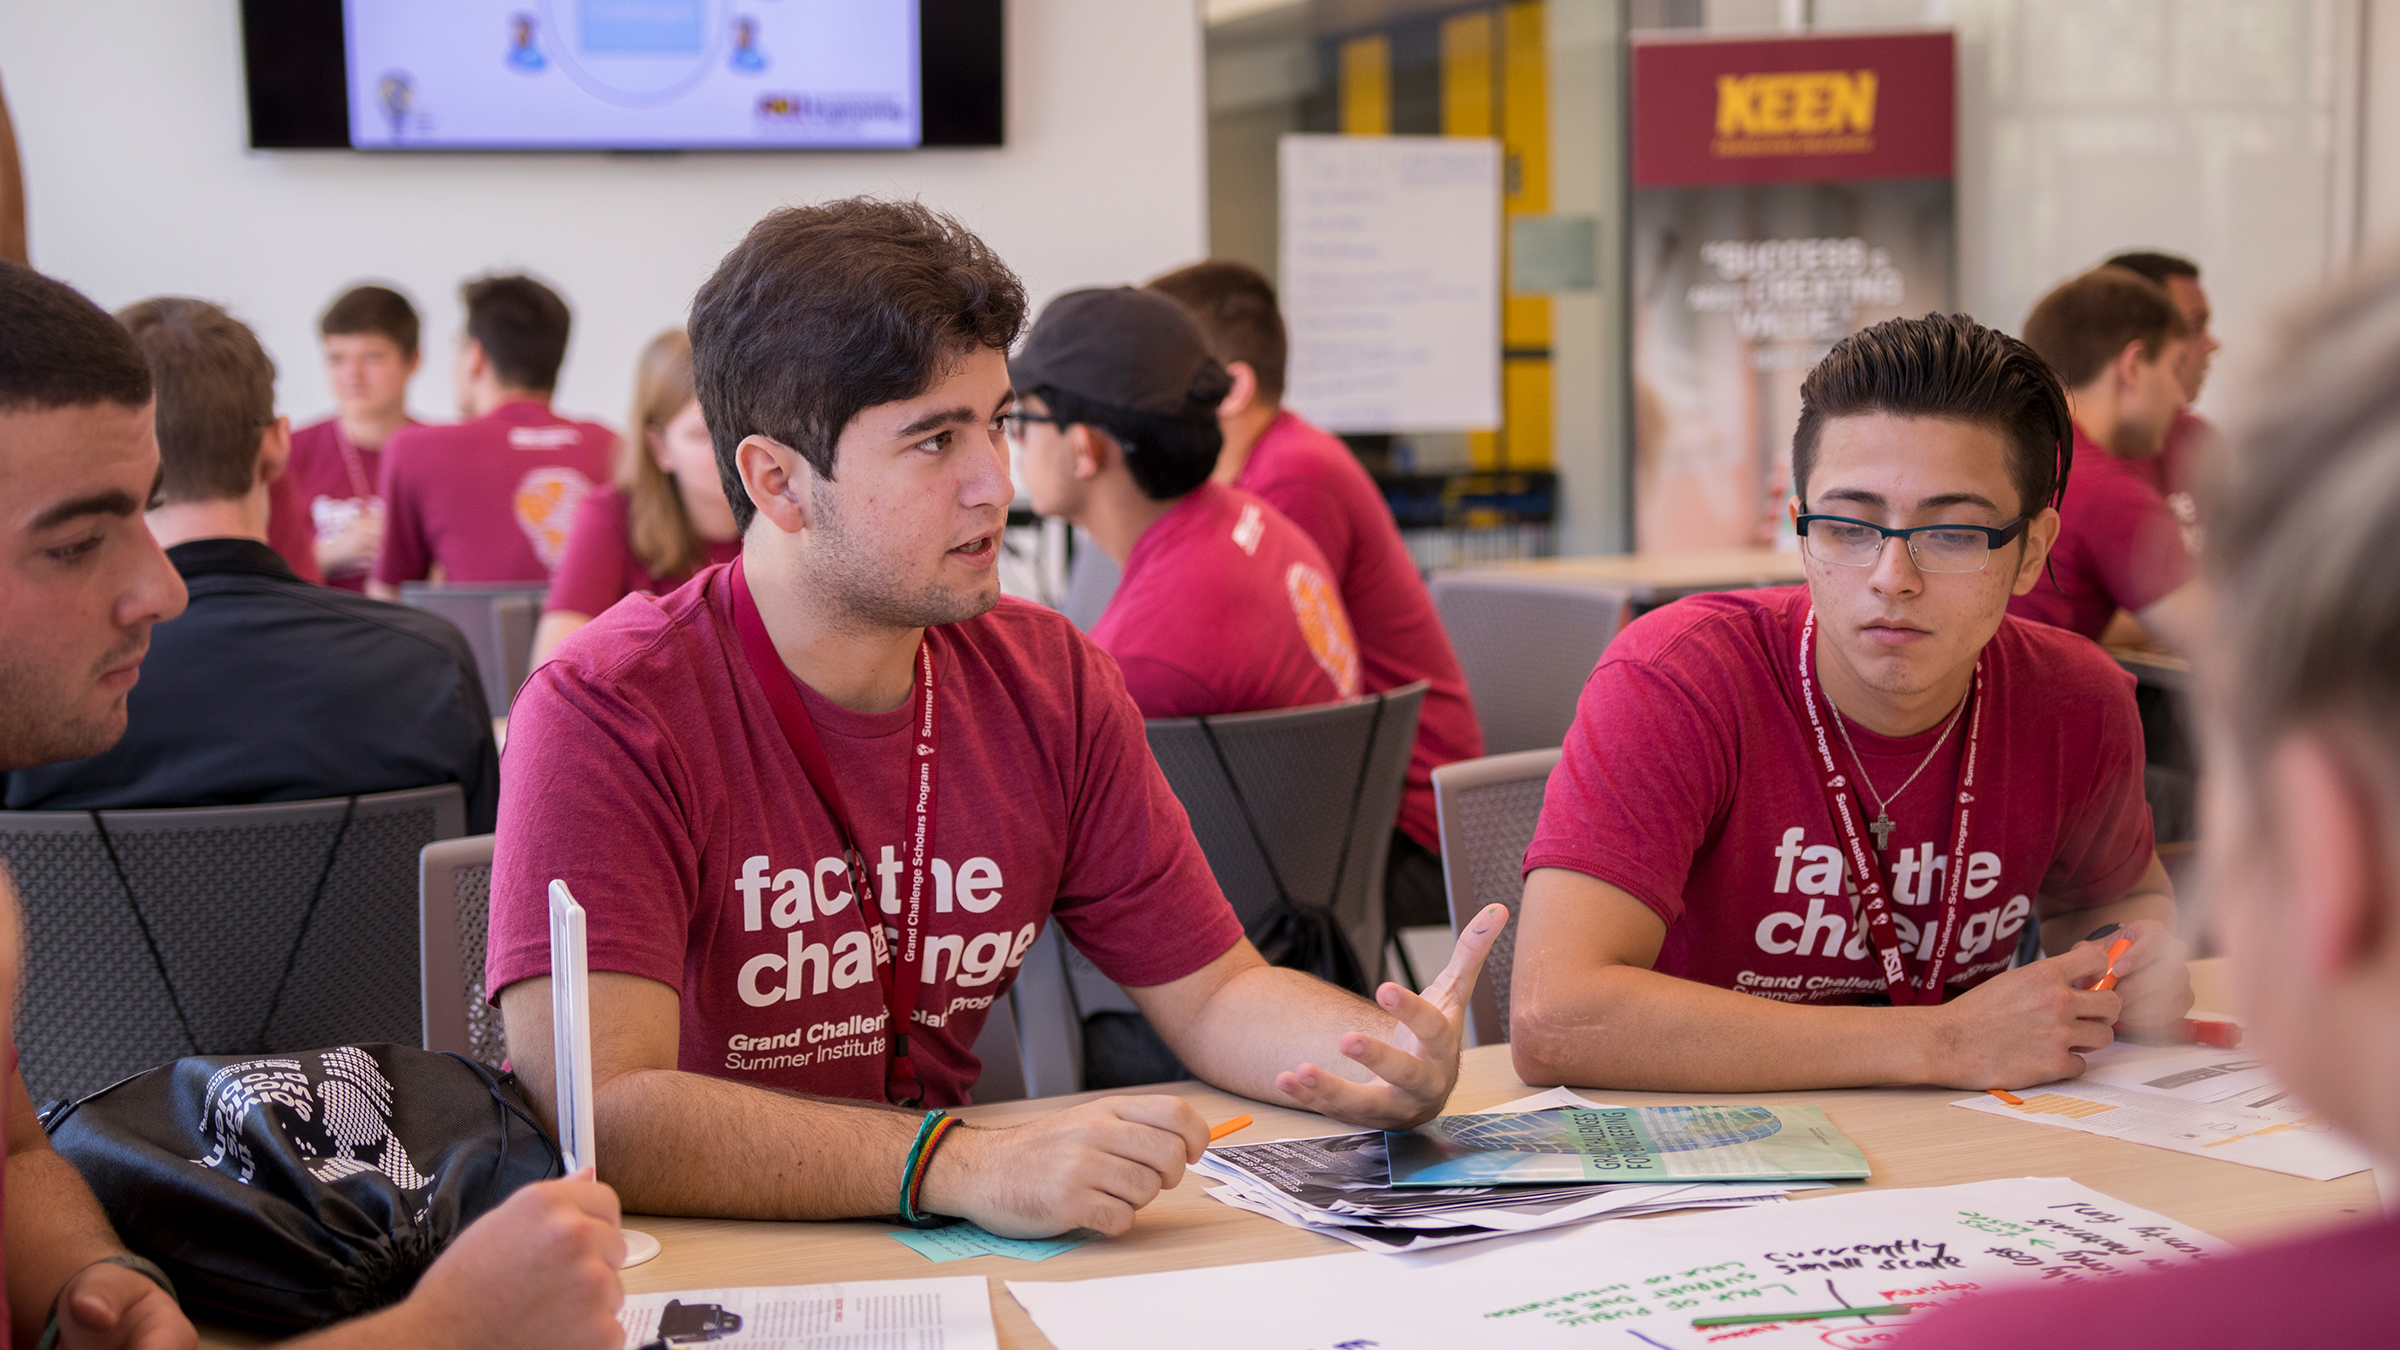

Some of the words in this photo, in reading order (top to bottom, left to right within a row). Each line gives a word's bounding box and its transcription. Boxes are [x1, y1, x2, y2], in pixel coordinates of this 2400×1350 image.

[1714, 69, 1880, 136] KEEN
[922, 642, 933, 687] Institute
[1799, 626, 1812, 678] Challenge
[921, 688, 934, 738] Summer
[1801, 678, 1820, 727] Scholars
[1814, 725, 1836, 773] Program
[1964, 740, 1977, 787] Summer
[916, 762, 931, 813] Program
[1835, 792, 1856, 837] Summer
[1955, 809, 1969, 857] Program
[912, 814, 927, 867] Scholars
[1849, 835, 1870, 881] Institute
[734, 849, 867, 932] fac
[1891, 842, 2001, 905] the
[1948, 855, 1964, 904] Scholars
[907, 868, 924, 926] Challenge
[870, 923, 890, 967] ASU
[904, 927, 918, 962] Grand
[1937, 904, 1956, 958] Challenge
[737, 922, 1036, 1008] change
[1736, 969, 1803, 990] Grand
[1881, 946, 1904, 985] ASU
[1926, 957, 1943, 991] Grand
[728, 1028, 802, 1051] Grand
[947, 995, 994, 1015] Prog
[724, 1051, 814, 1070] Summer
[816, 1036, 887, 1064] Institute
[234, 1091, 313, 1136] solve
[1601, 1111, 1647, 1152] ENGINEERING
[1622, 1153, 1654, 1170] FOR
[1764, 1238, 1950, 1265] currently
[1774, 1257, 1863, 1275] small
[1877, 1253, 1967, 1272] scale
[1583, 1295, 1639, 1311] DUE
[1653, 1271, 1757, 1300] SUPPORT
[1666, 1298, 1700, 1311] OF
[1558, 1306, 1652, 1327] PUBLIC
